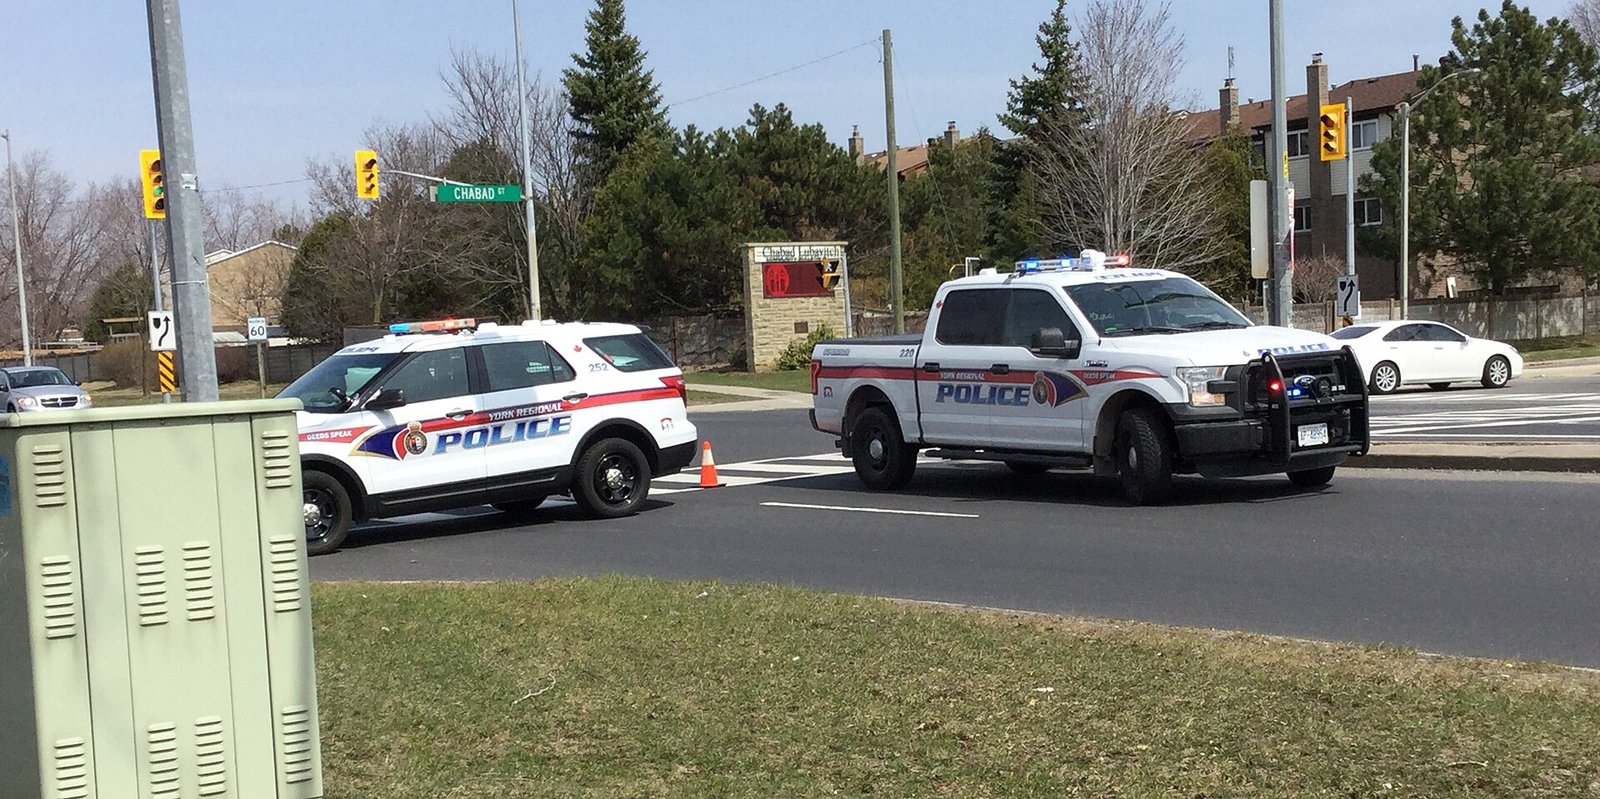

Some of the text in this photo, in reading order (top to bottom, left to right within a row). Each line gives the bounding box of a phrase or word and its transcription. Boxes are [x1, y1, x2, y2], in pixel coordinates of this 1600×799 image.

[454, 187, 495, 200] CHABAD
[762, 246, 795, 258] Chabad
[250, 326, 264, 336] 60
[899, 348, 915, 358] 220
[588, 362, 609, 373] 252
[939, 371, 985, 381] YORK REGIONAL
[935, 383, 1031, 407] POLICE
[488, 402, 564, 422] YORK REGIONAL
[306, 430, 353, 441] DEEDS SPEAK
[433, 415, 572, 455] POLICE
